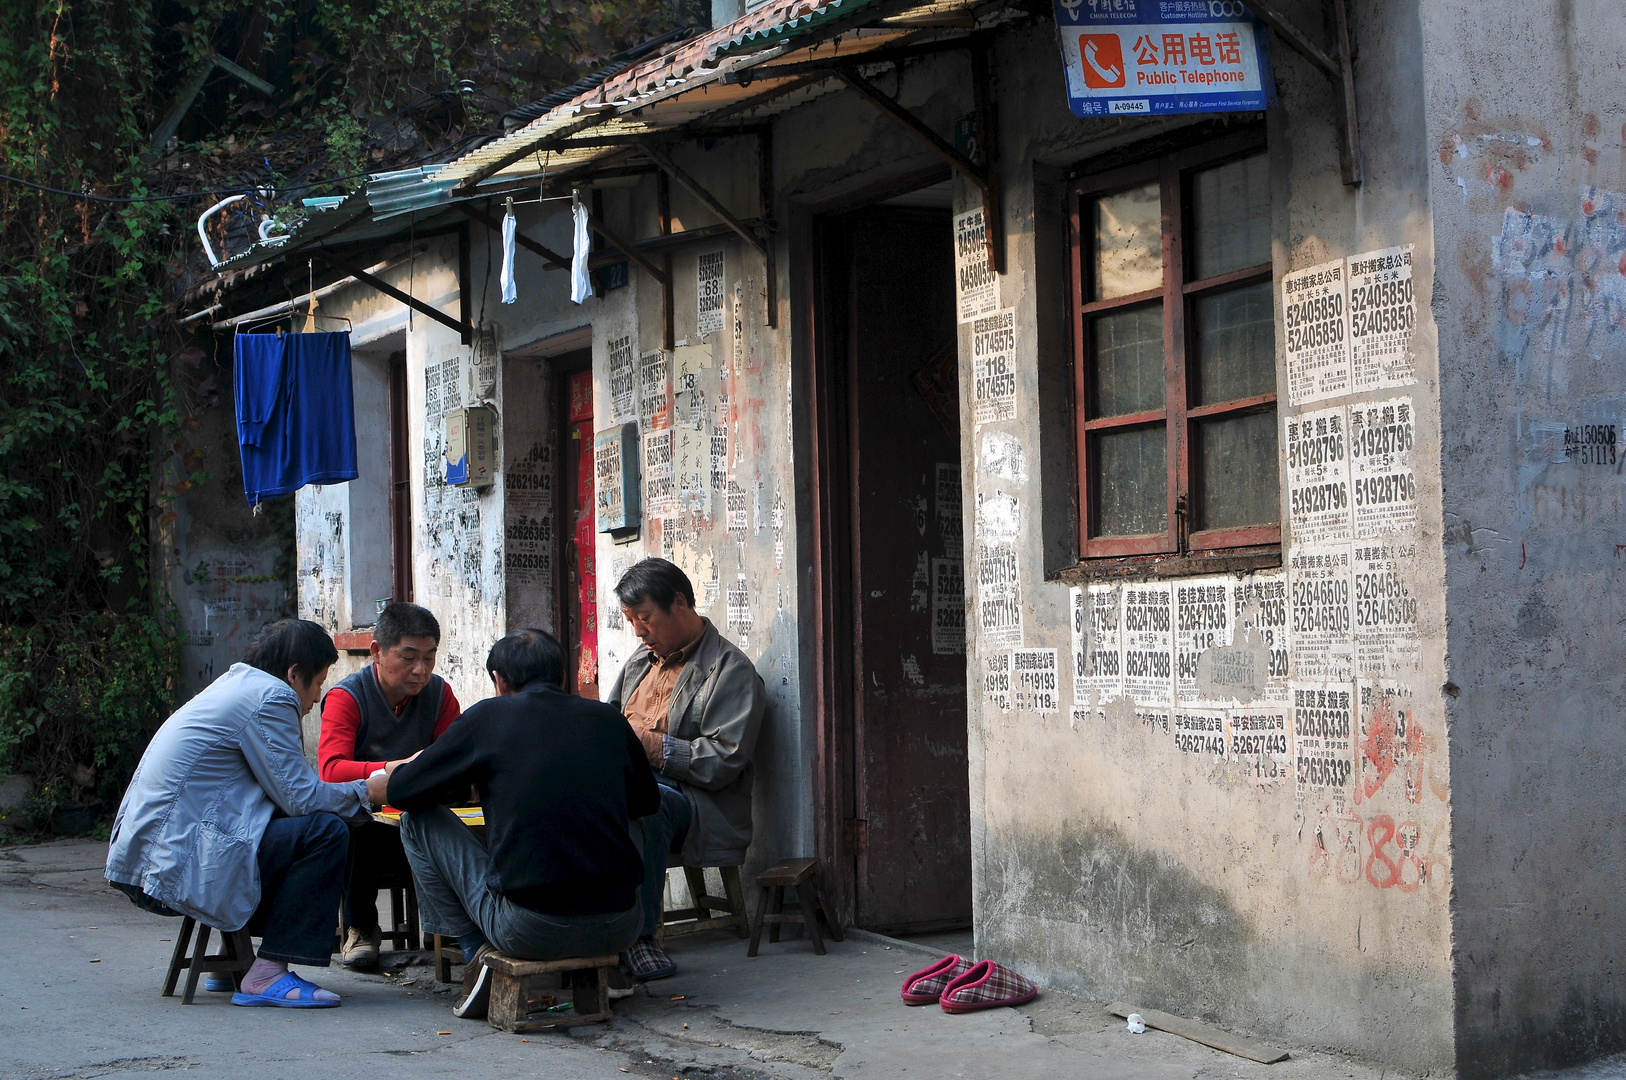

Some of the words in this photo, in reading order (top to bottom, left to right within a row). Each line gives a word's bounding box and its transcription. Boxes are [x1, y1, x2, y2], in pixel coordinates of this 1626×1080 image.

[1088, 0, 1136, 11] 中国电信
[1159, 1, 1207, 12] 客户服务热线
[1187, 11, 1208, 19] Hotline
[1132, 32, 1241, 67] 公用电话
[1137, 70, 1177, 86] Public
[1178, 69, 1246, 86] Telephone
[1114, 102, 1144, 111] A-09445
[1350, 251, 1412, 278] 惠好搬家总公司
[611, 264, 622, 288] 22
[1285, 267, 1342, 295] 惠好搬家总公司
[1363, 271, 1399, 286] 加长5米
[704, 280, 719, 295] 68
[1297, 286, 1330, 302] 加长5米
[1351, 278, 1413, 313] 52405850
[1286, 293, 1343, 328] 52405850
[1352, 304, 1414, 337] 52405850
[975, 329, 1015, 357] 81745575
[1287, 318, 1344, 353] 52405850
[985, 355, 1007, 377] 118
[428, 388, 439, 401] 68
[447, 380, 458, 395] 68
[976, 372, 1016, 400] 81745575
[1287, 414, 1344, 442] 惠好搬家
[1288, 434, 1345, 469] 51928796
[505, 473, 551, 490] 52621942
[1355, 472, 1416, 507] 51928796
[1291, 481, 1349, 516] 51928796
[506, 525, 551, 541] 52626365
[506, 553, 551, 570] 52626365
[979, 557, 1017, 586] 85977115
[1291, 554, 1349, 570] 双喜搬家总公司
[1126, 590, 1171, 606] 秦淮搬家
[1178, 585, 1227, 605] 佳佳发搬家
[1234, 580, 1286, 602] 佳佳发搬家
[1292, 579, 1349, 607] 52646509
[982, 598, 1020, 628] 85977115
[1126, 605, 1171, 633] 86247988
[1293, 605, 1350, 633] 52646509
[1126, 650, 1172, 678] 86247988
[1294, 689, 1350, 710] 路路发搬家
[1174, 714, 1223, 733] 平安搬家公司
[1233, 714, 1285, 732] 平安搬家公司
[1295, 708, 1350, 739] 52636338
[1174, 734, 1225, 756] 52627443
[1233, 734, 1287, 755] 52627443
[1324, 740, 1349, 750] 步步高升
